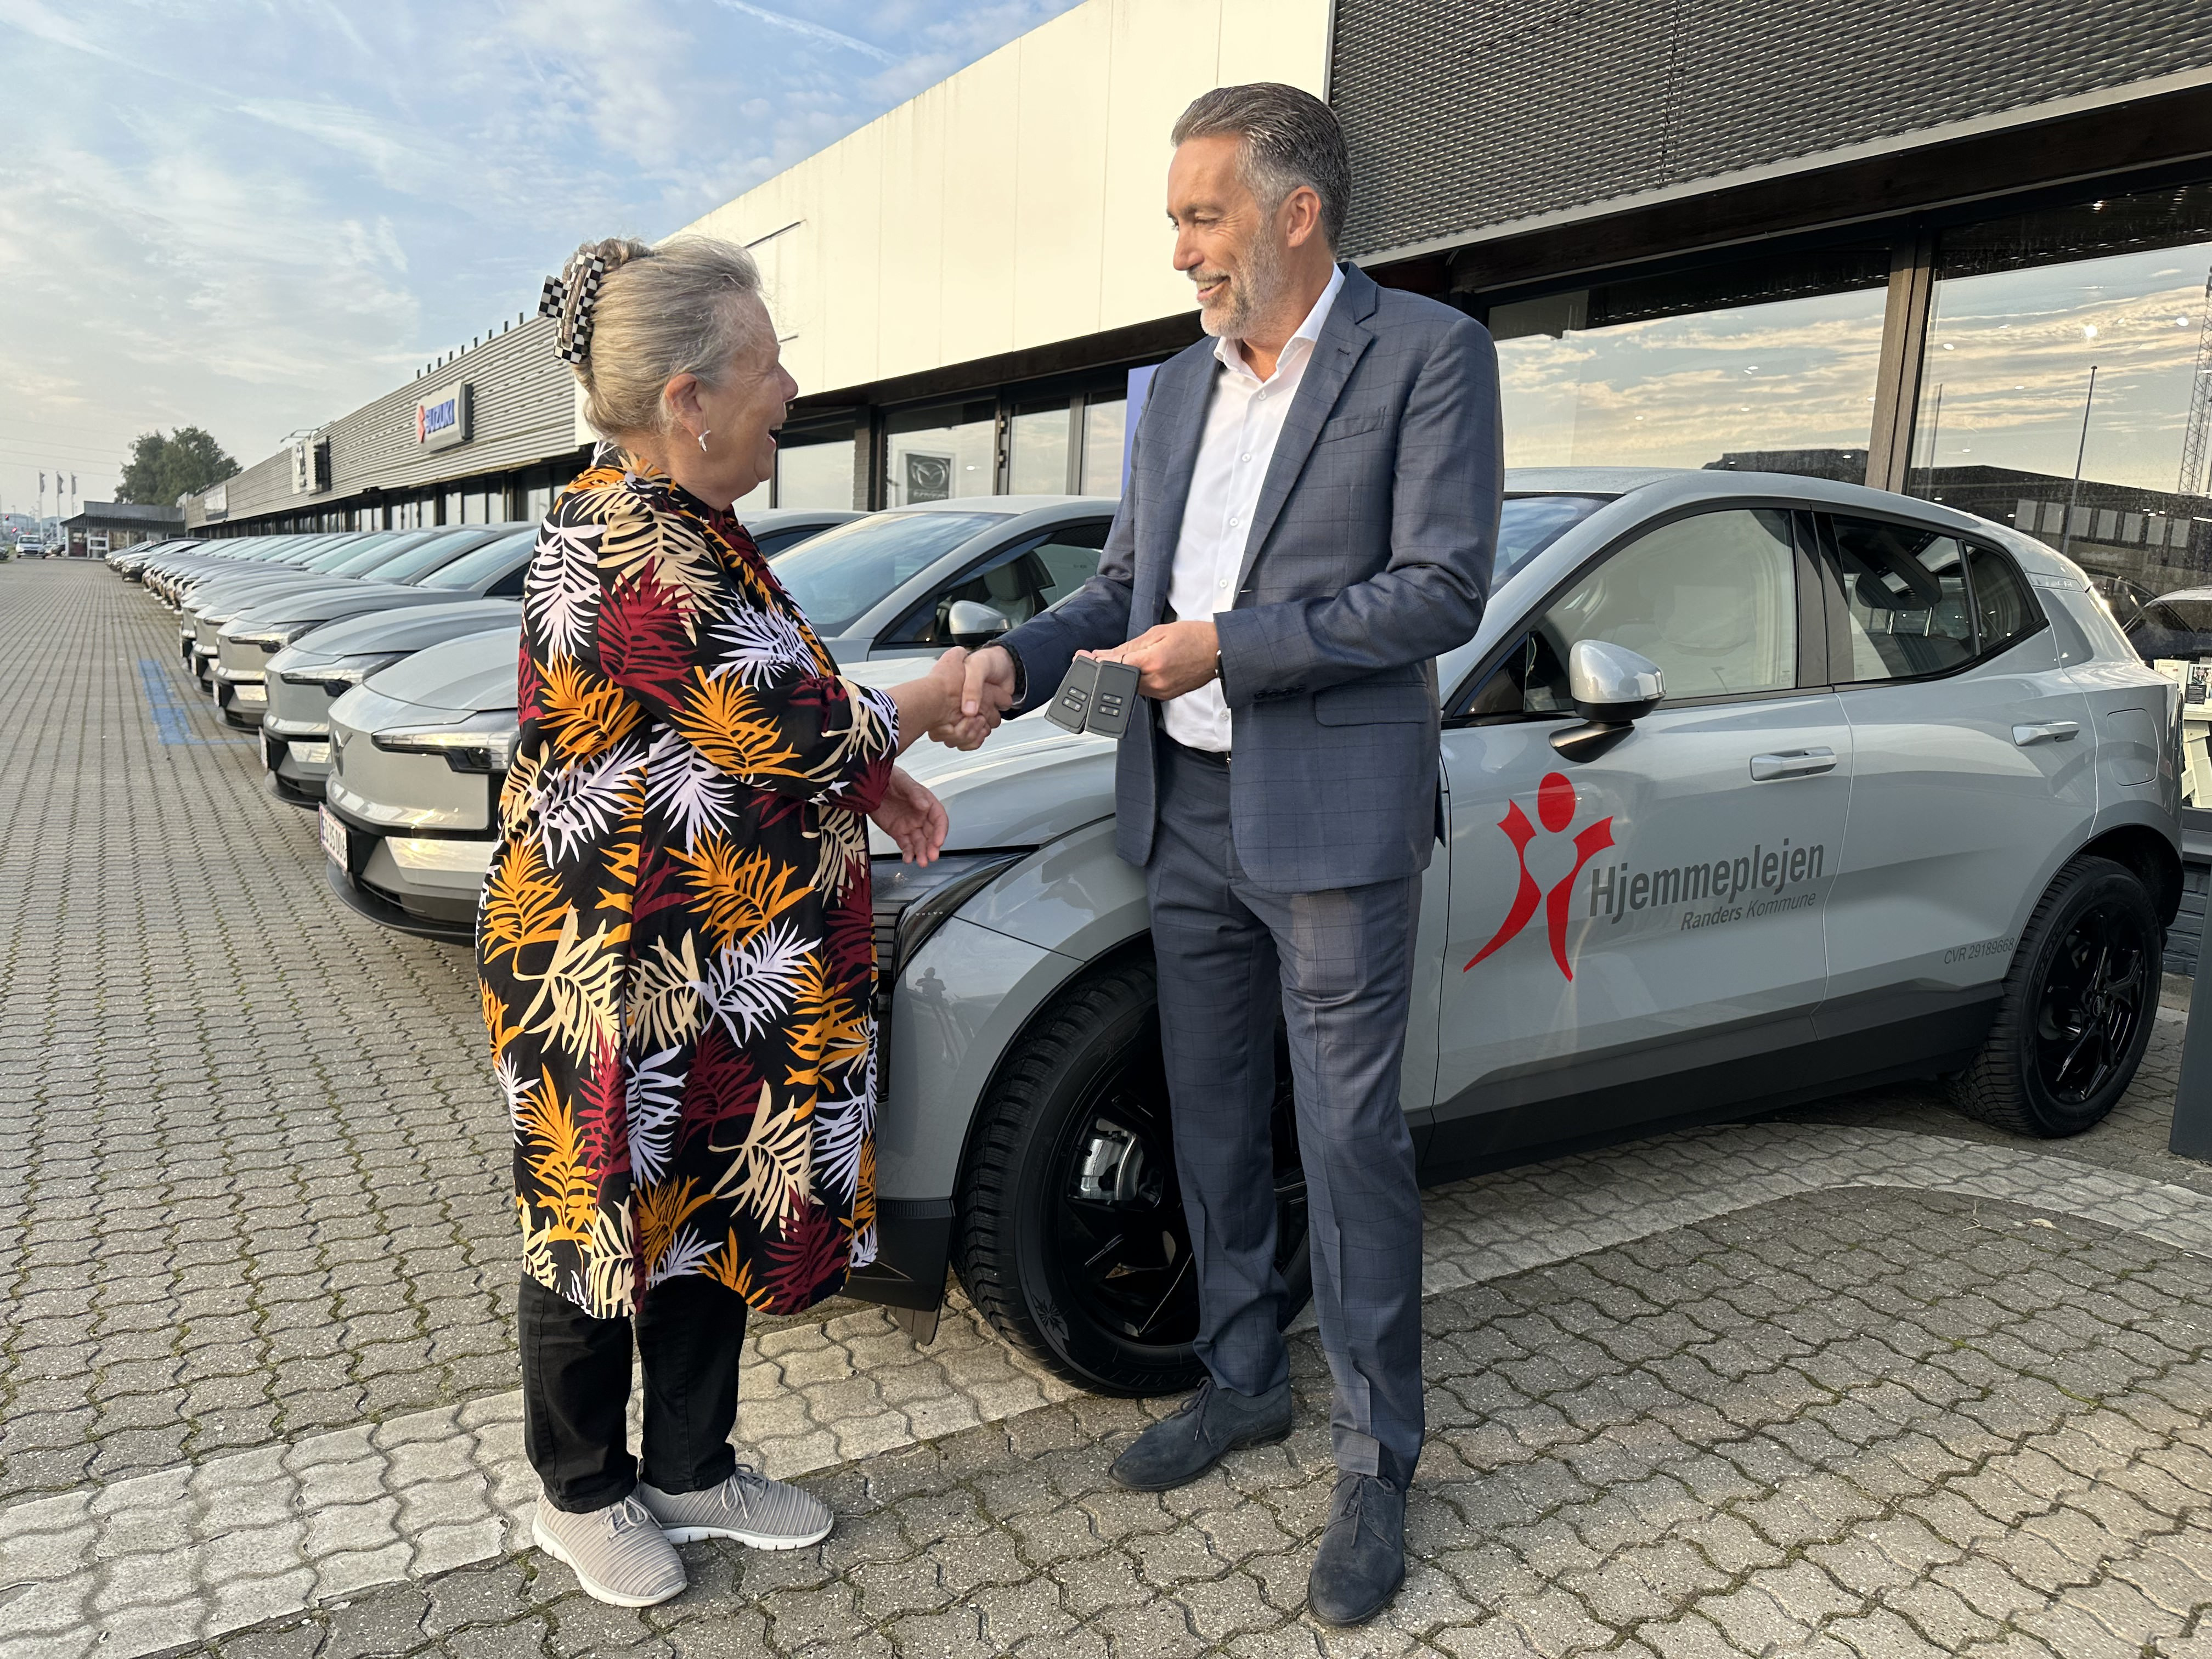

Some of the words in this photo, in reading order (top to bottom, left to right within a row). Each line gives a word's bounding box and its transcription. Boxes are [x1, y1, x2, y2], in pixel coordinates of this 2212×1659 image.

[426, 399, 455, 434] SUZUKI
[1589, 838, 1824, 924] Hjemmeplejen
[1680, 905, 1742, 931] Randers
[1746, 892, 1816, 919] Kommune
[1944, 947, 1967, 964] CVR
[1968, 937, 2015, 960] 29189668
